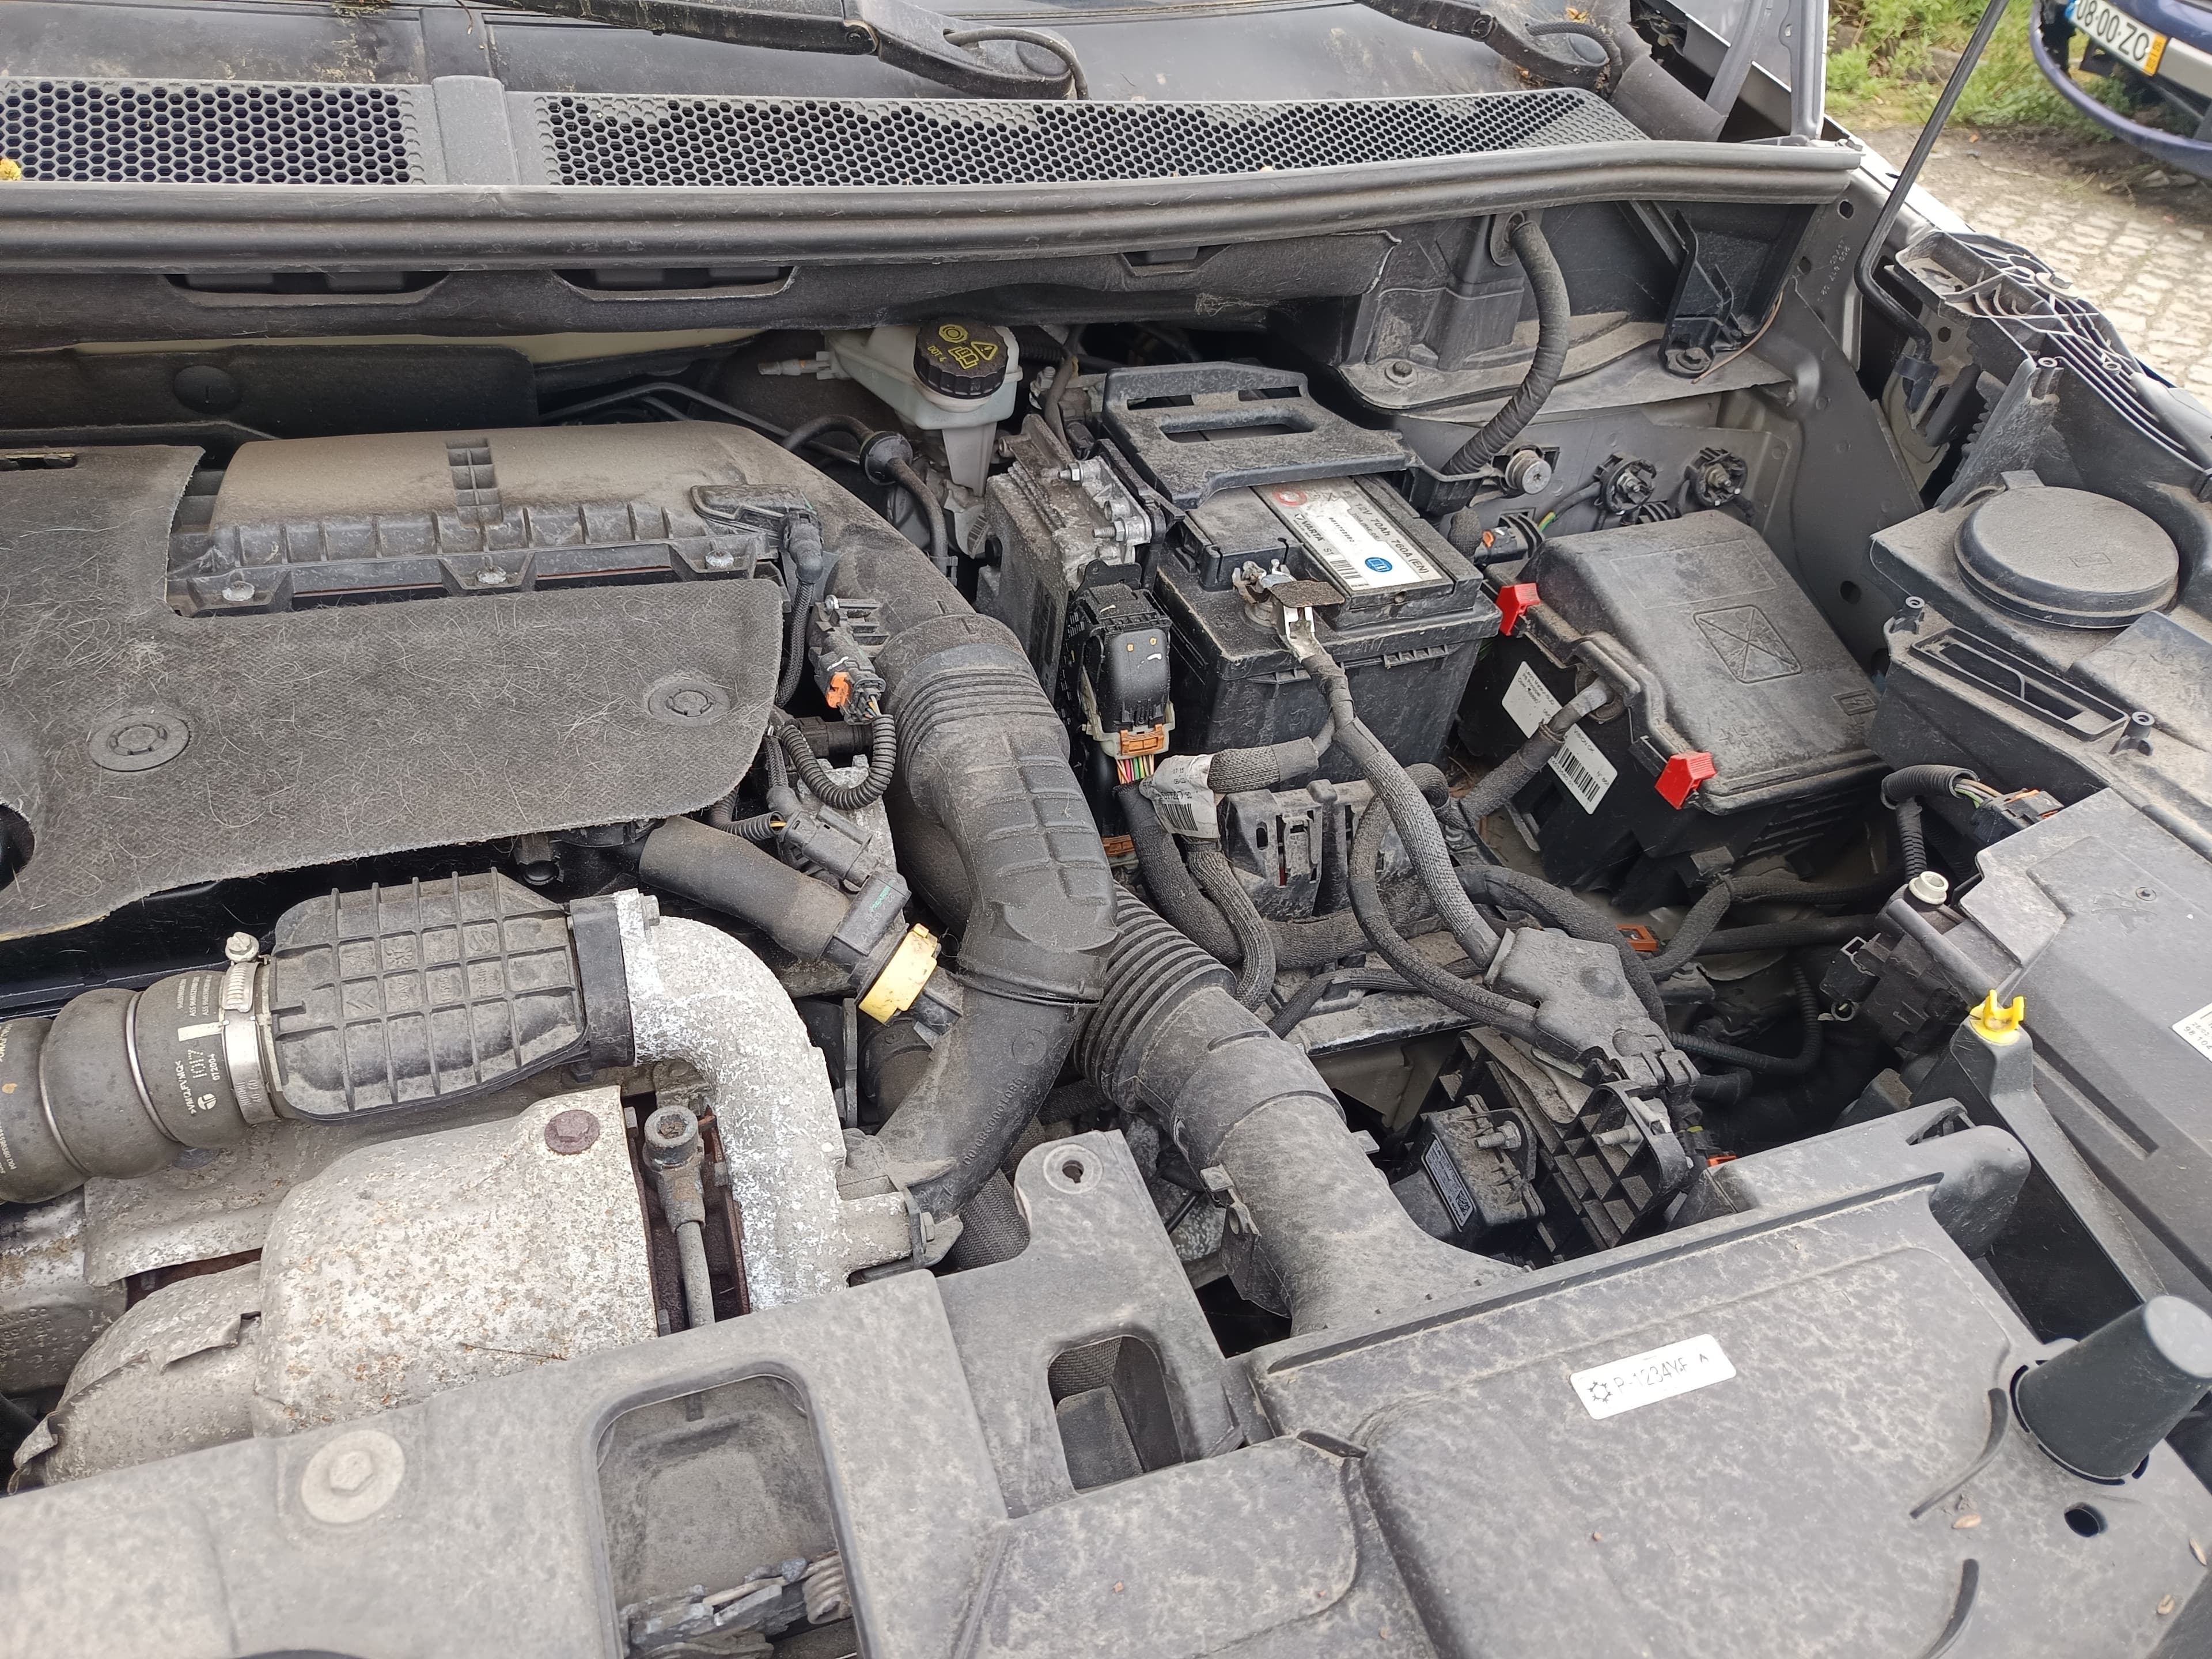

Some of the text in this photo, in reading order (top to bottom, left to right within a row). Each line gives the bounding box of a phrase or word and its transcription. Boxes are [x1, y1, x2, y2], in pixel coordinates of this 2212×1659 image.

[927, 345, 942, 357] DOT
[1302, 521, 1325, 543] VARTA
[1355, 503, 1372, 516] 12V
[1372, 517, 1391, 537] 70Ah
[1391, 539, 1412, 558] 760A
[1408, 556, 1430, 575] (EN)
[1323, 547, 1334, 556] S1
[2184, 1026, 2196, 1036] 98
[209, 1053, 220, 1081] 072004
